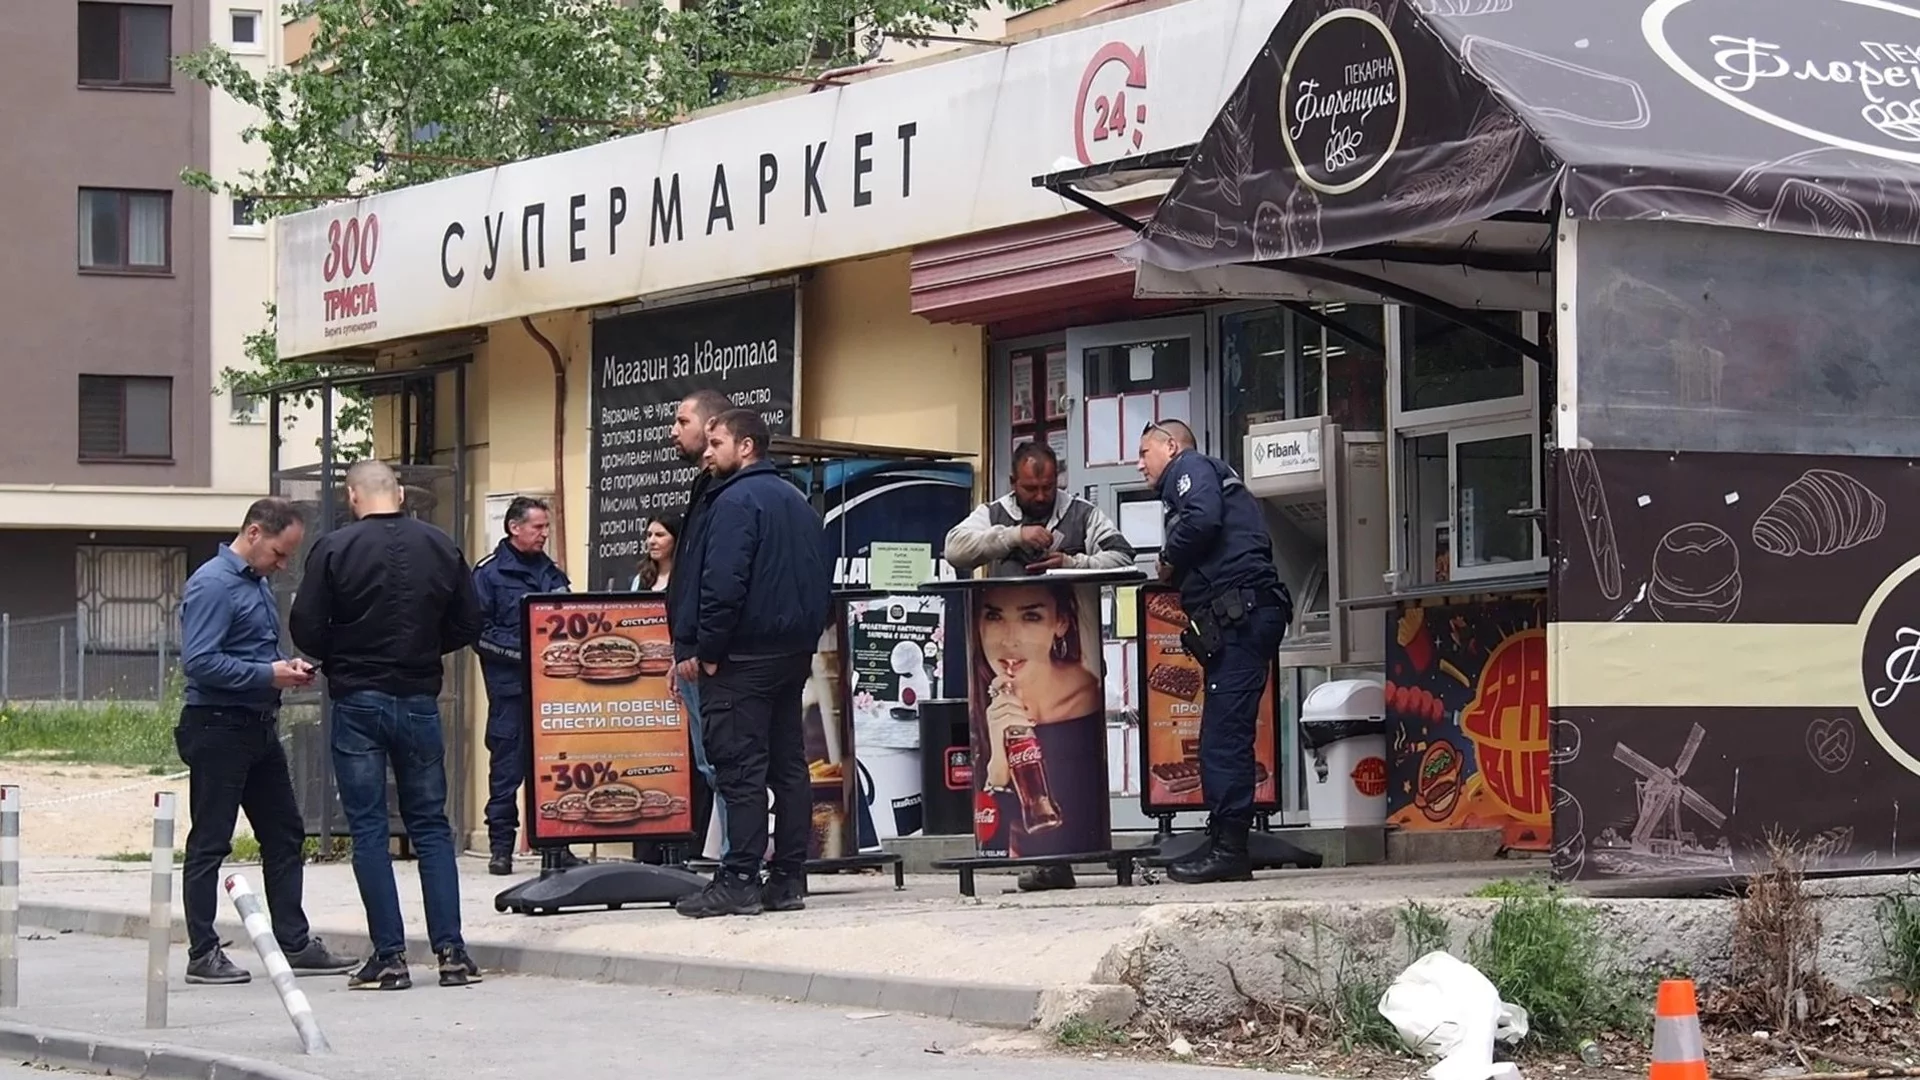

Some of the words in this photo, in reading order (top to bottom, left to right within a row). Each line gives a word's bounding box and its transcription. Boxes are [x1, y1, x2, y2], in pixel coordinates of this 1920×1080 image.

[1860, 40, 1920, 64] ПЕК
[1344, 56, 1395, 86] ПЕКАРНА
[1093, 90, 1127, 142] 24
[1290, 79, 1397, 140] Флоренция
[440, 121, 918, 289] СУПЕРМАРКЕТ
[323, 212, 379, 283] 300
[323, 282, 378, 322] ТРИСТА
[602, 355, 668, 389] Магазин
[672, 352, 690, 378] за
[694, 338, 778, 380] квартала
[643, 404, 655, 420] че
[656, 400, 682, 421] чувст
[643, 424, 675, 443] кварта
[1267, 440, 1301, 458] Fibank
[600, 476, 613, 491] се
[660, 470, 671, 485] за
[640, 493, 650, 509] че
[652, 490, 691, 509] спретна
[536, 612, 612, 641] -20%
[540, 702, 601, 715] ВЗЕМИ
[1171, 703, 1203, 714] ПРО
[541, 717, 606, 729] СПЕСТИ
[611, 715, 681, 727] ПОВЕЧЕ!
[541, 761, 618, 792] -30%
